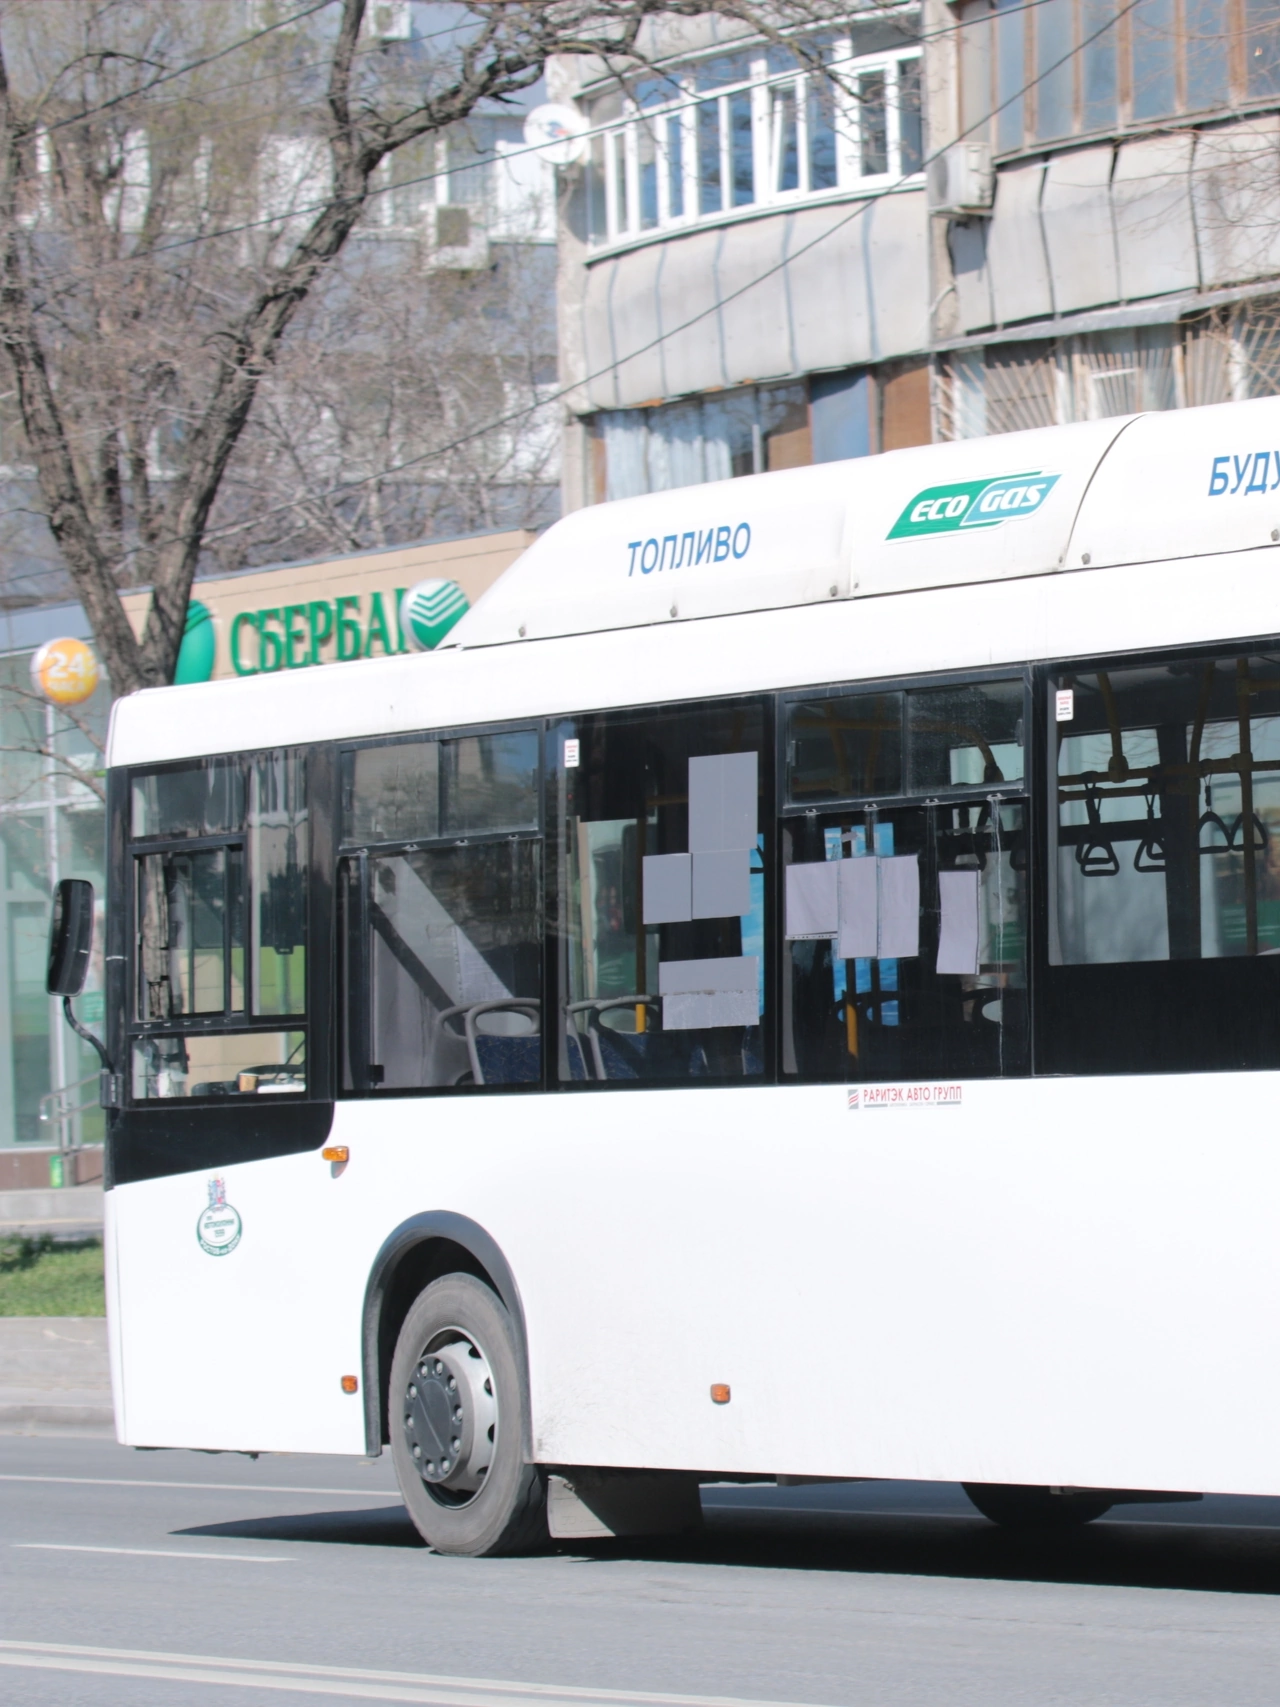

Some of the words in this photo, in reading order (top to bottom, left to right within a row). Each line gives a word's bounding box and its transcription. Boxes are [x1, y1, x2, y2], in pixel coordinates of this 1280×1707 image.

[910, 495, 970, 522] ECO
[628, 522, 751, 577] ТОПЛИВО
[49, 651, 84, 678] 24
[863, 1088, 904, 1102] РАРИТЭК
[907, 1087, 931, 1101] АВТО
[934, 1086, 962, 1100] ГРУПП
